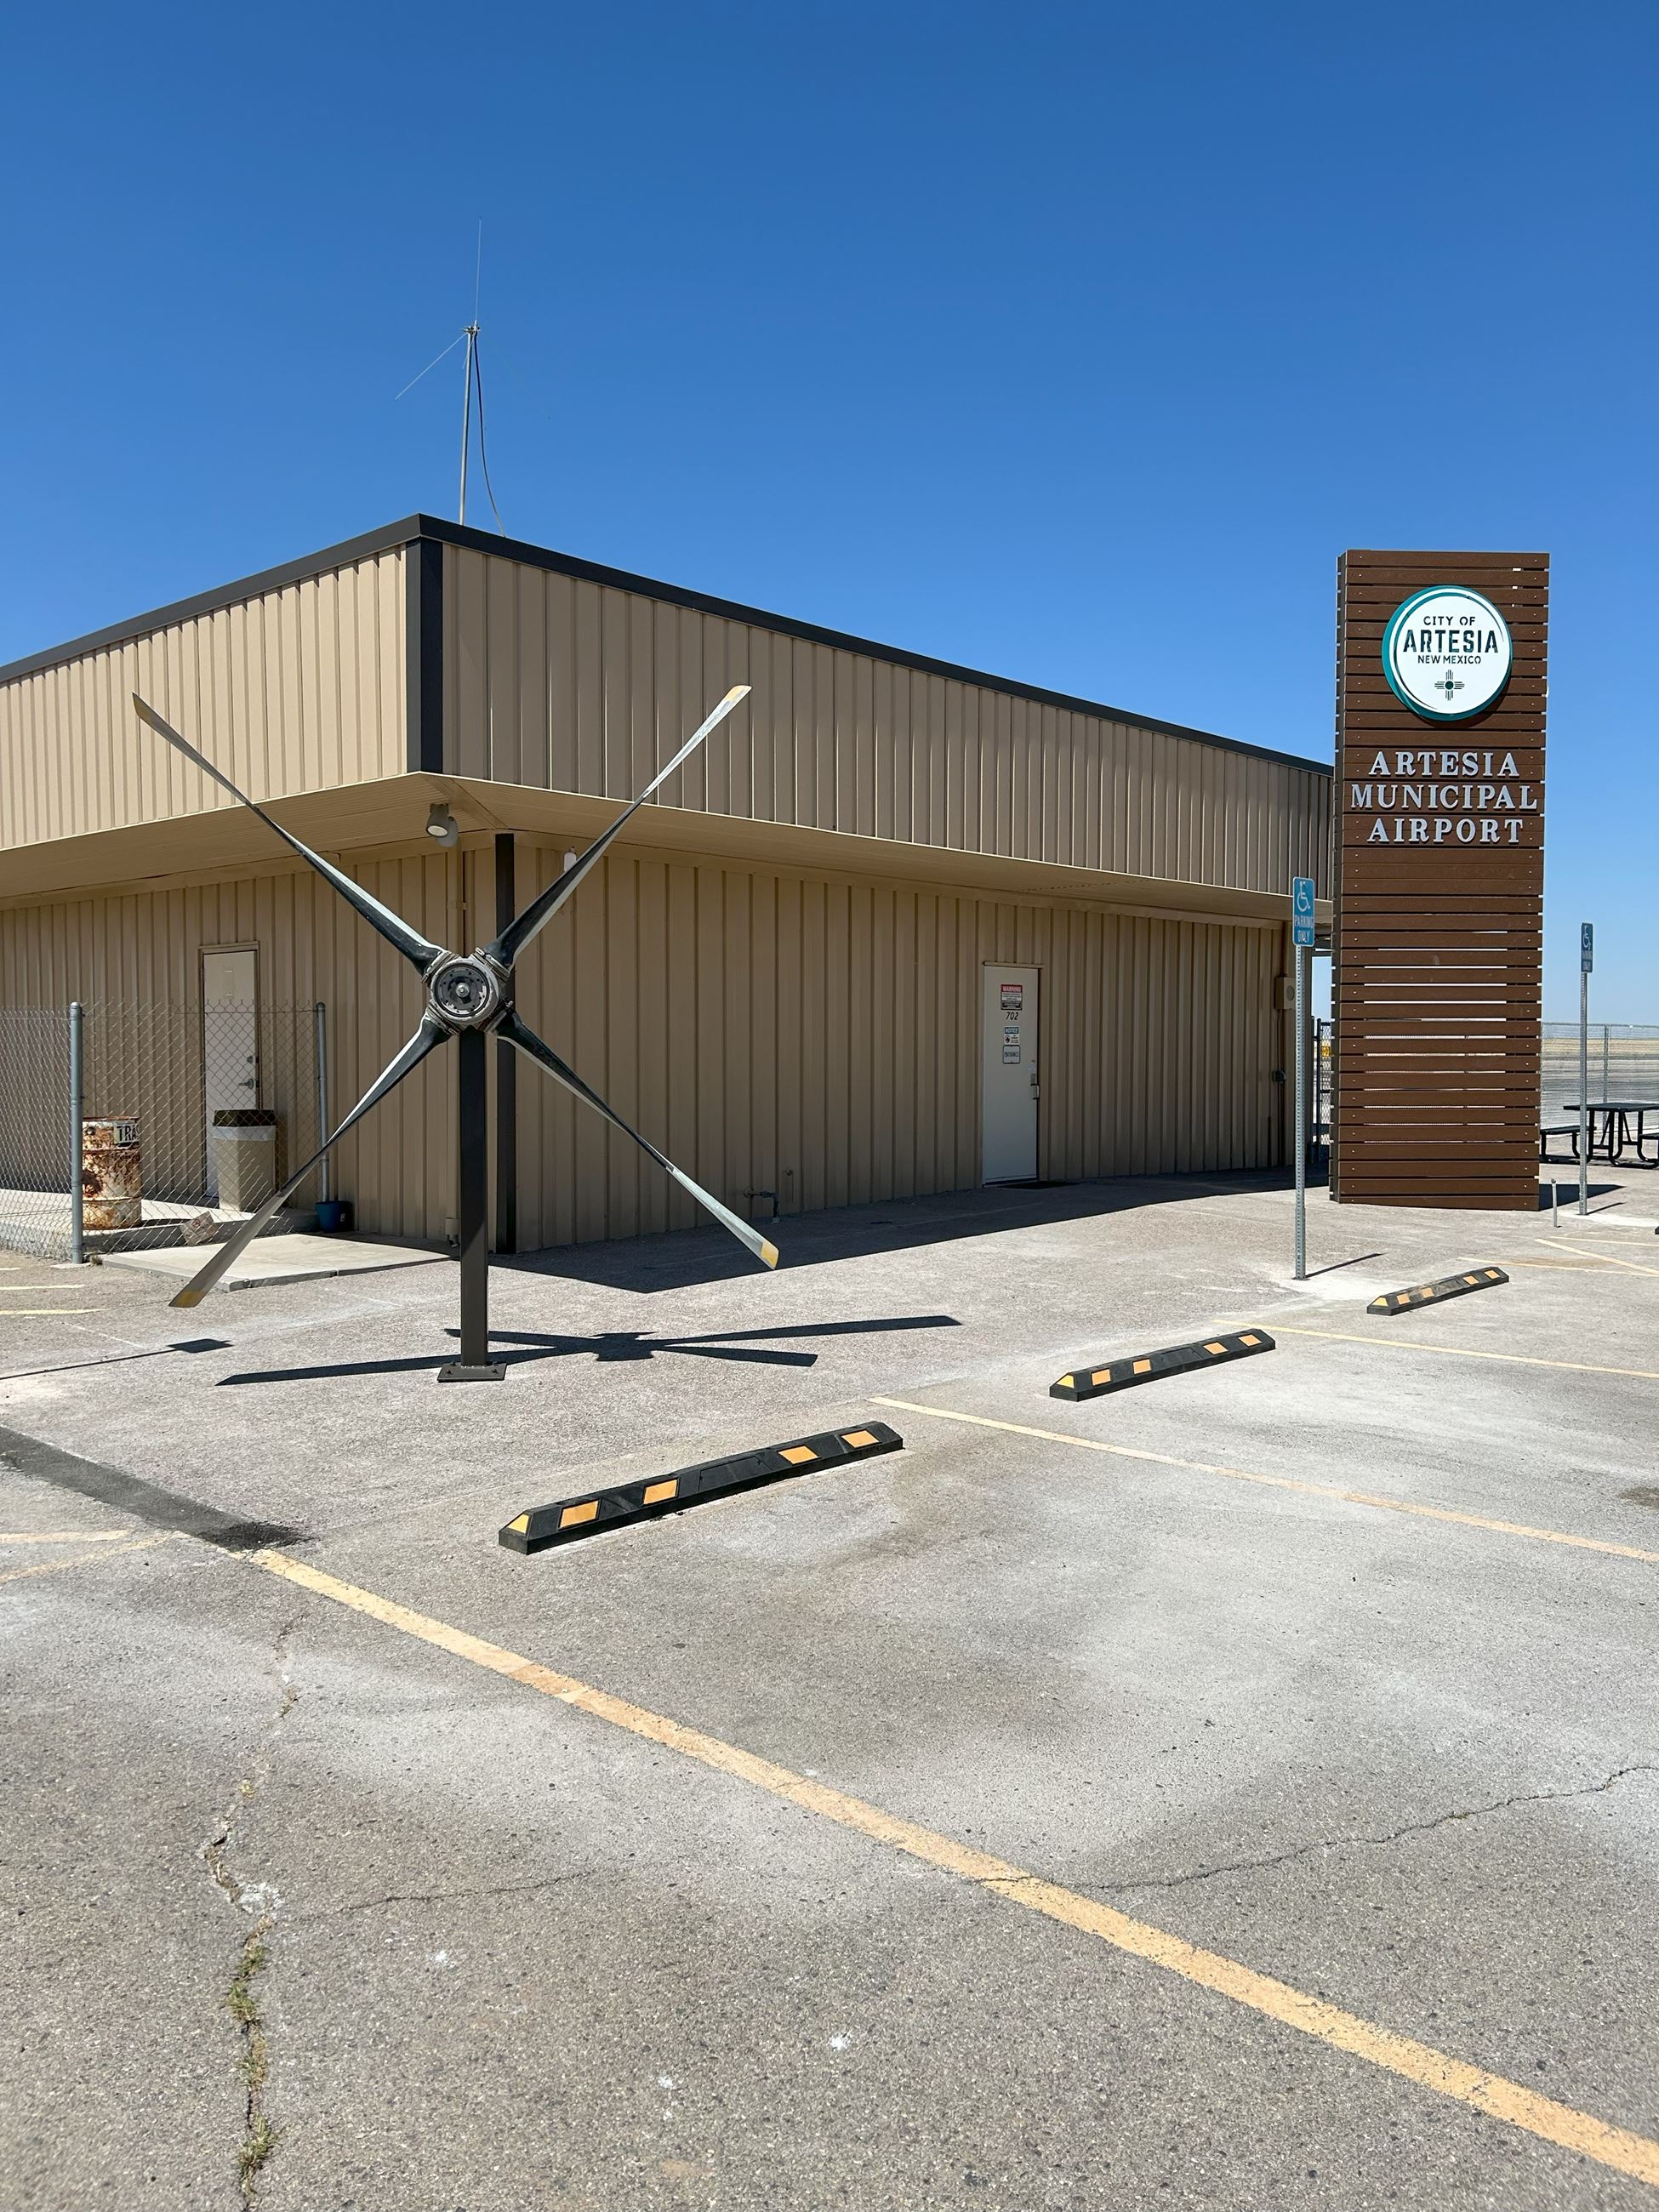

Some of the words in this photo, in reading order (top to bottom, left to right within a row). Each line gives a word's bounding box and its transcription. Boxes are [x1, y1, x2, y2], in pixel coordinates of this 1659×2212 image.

[1423, 615, 1453, 626] CITY
[1460, 615, 1476, 626] OF
[1403, 629, 1498, 653] ARTESIA
[1417, 654, 1441, 664] NEW
[1443, 655, 1481, 664] MEXICO
[1368, 750, 1519, 778] ARTESIA
[1350, 784, 1537, 810] MUNICIPAL
[1367, 818, 1524, 844] AIRPORT
[1294, 915, 1314, 928] PARKING
[1006, 1012, 1019, 1021] 702
